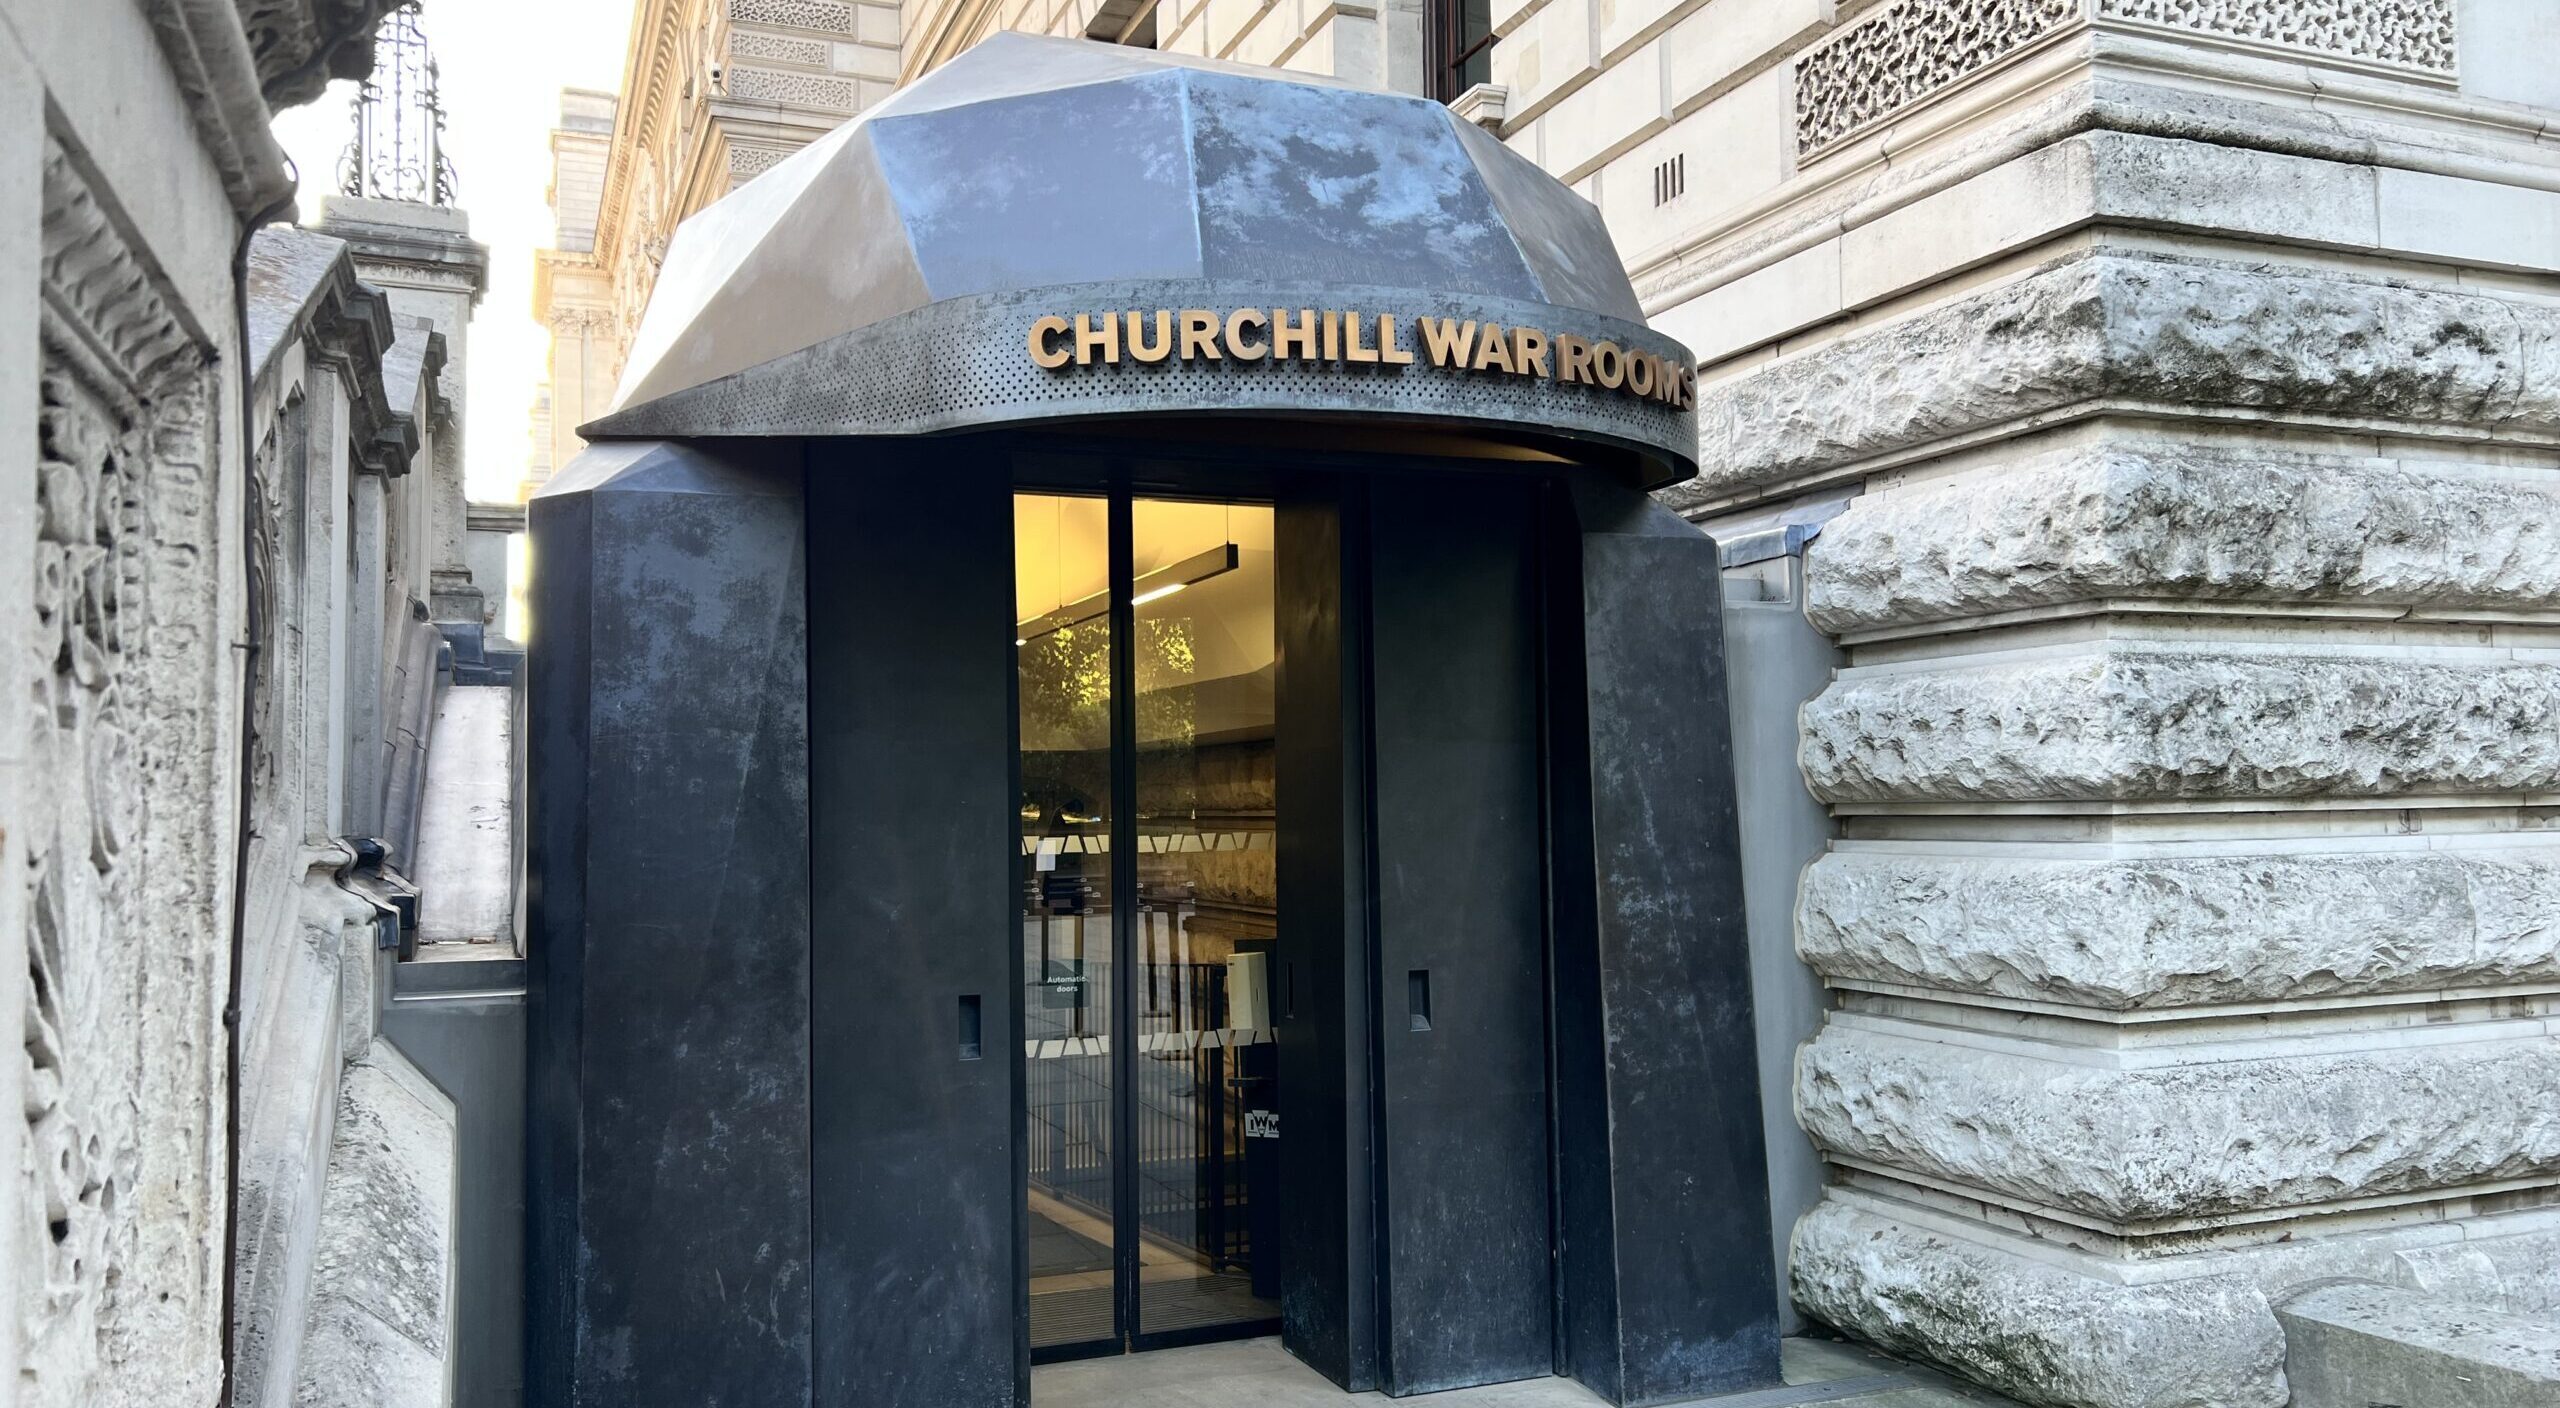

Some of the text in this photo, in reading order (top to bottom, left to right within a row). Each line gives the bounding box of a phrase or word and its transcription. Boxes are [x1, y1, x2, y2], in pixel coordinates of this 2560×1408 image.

[1028, 309, 1696, 412] CHURCHILL WAR ROOMS
[1047, 976, 1087, 984] Automatic
[1056, 985, 1078, 993] doors
[1249, 1113, 1280, 1132] IWM
